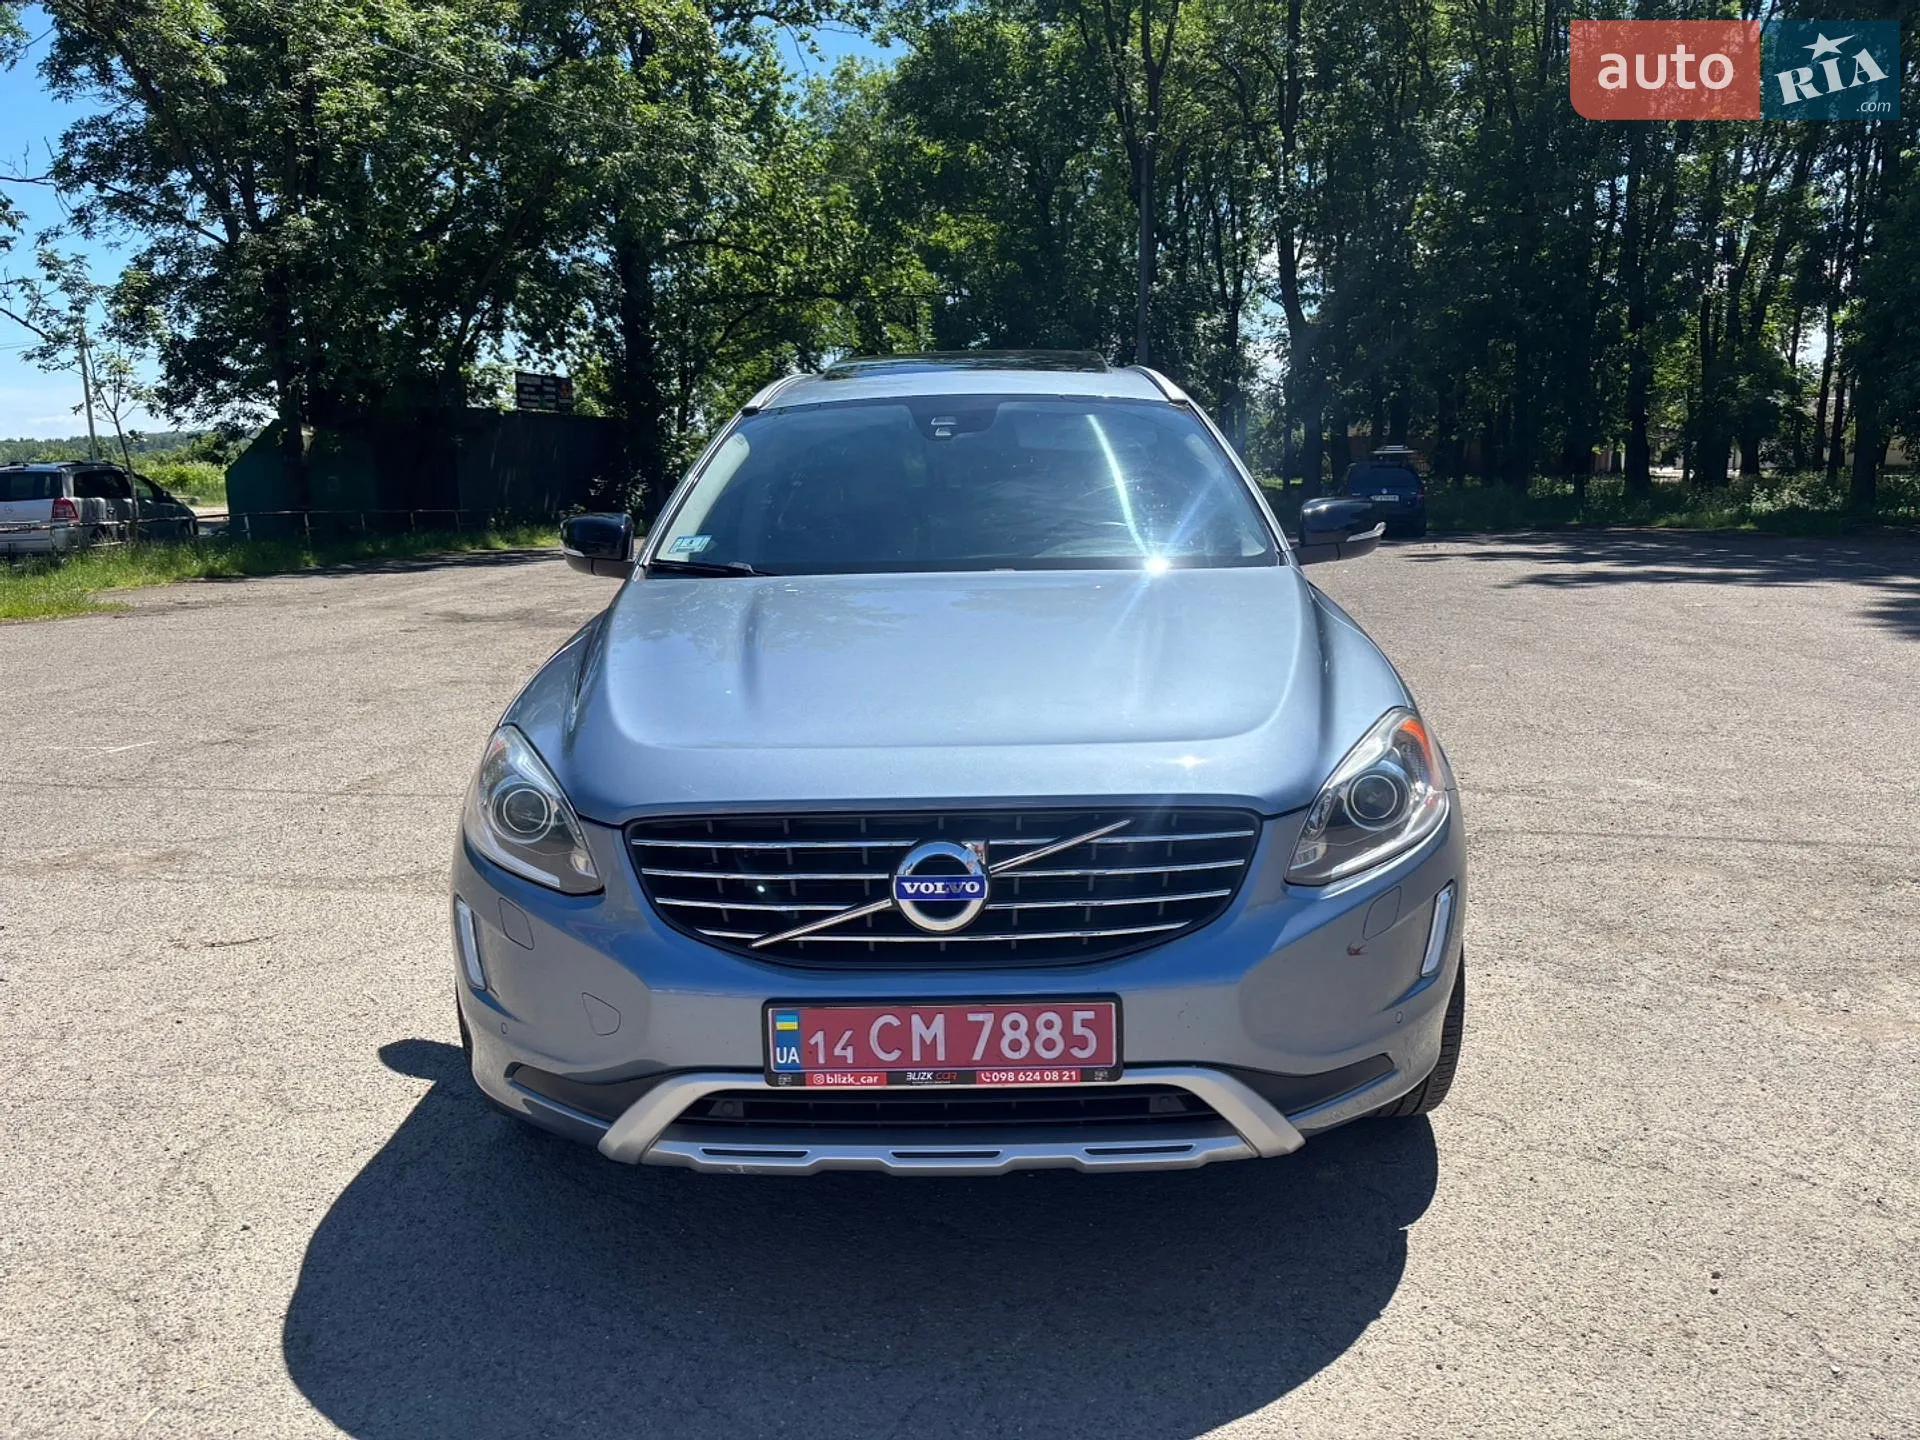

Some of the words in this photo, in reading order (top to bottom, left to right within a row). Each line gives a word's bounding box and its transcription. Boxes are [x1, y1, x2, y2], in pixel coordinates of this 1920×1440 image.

[901, 881, 980, 894] VOLVO
[808, 1030, 854, 1064] 14
[869, 1013, 945, 1062] CM
[967, 1010, 1098, 1061] 7885
[776, 1047, 800, 1064] UA
[826, 1073, 879, 1085] blizk_car
[991, 1071, 1015, 1082] 098
[1018, 1071, 1041, 1081] 624
[1043, 1070, 1059, 1081] 08
[1062, 1070, 1076, 1080] 21
